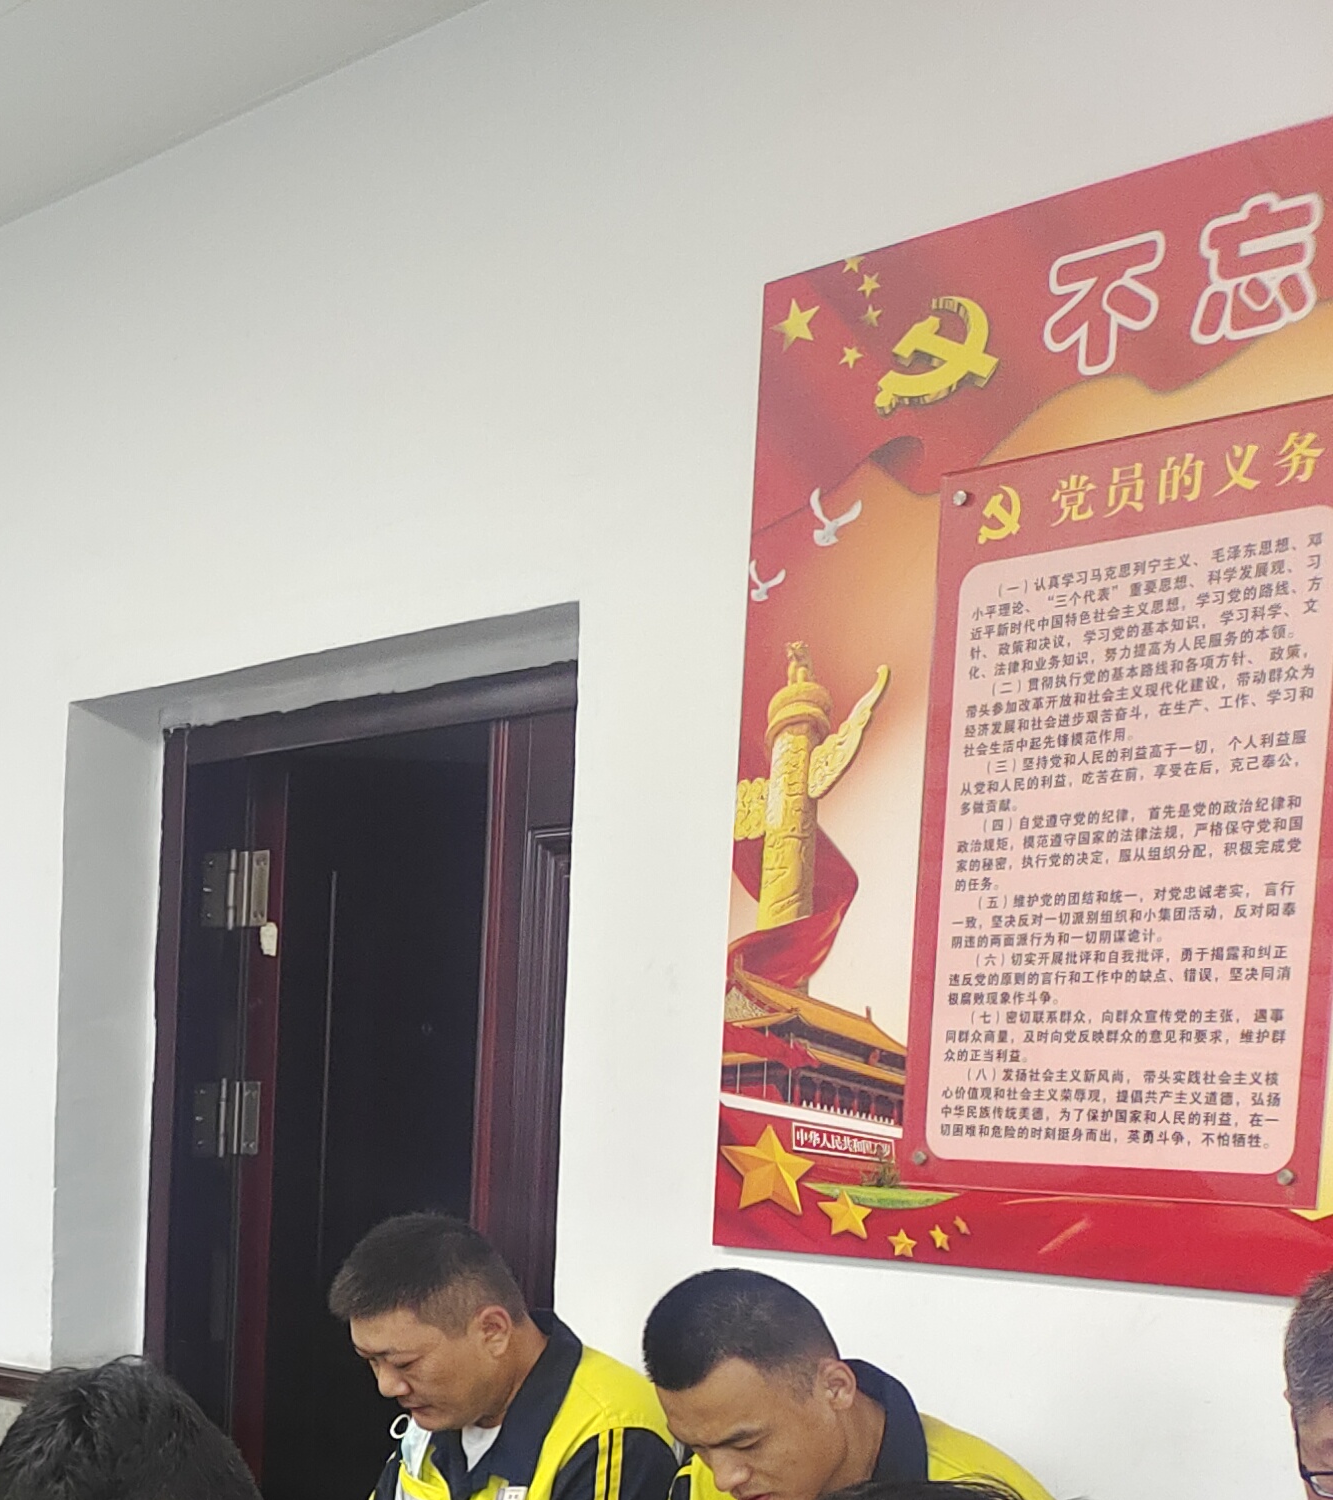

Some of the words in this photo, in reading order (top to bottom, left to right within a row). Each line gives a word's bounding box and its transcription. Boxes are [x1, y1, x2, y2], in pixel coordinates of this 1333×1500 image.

[1044, 192, 1325, 376] 不忘
[1050, 432, 1326, 527] 党员的义务
[962, 727, 1134, 758] 社会生活中起先锋模范作用。
[959, 799, 1018, 816] 多做贡献。
[954, 876, 1001, 892] 的任务。
[948, 991, 1060, 1006] 极腐败现象作斗争。
[944, 1048, 1029, 1063] 众的正当利益。
